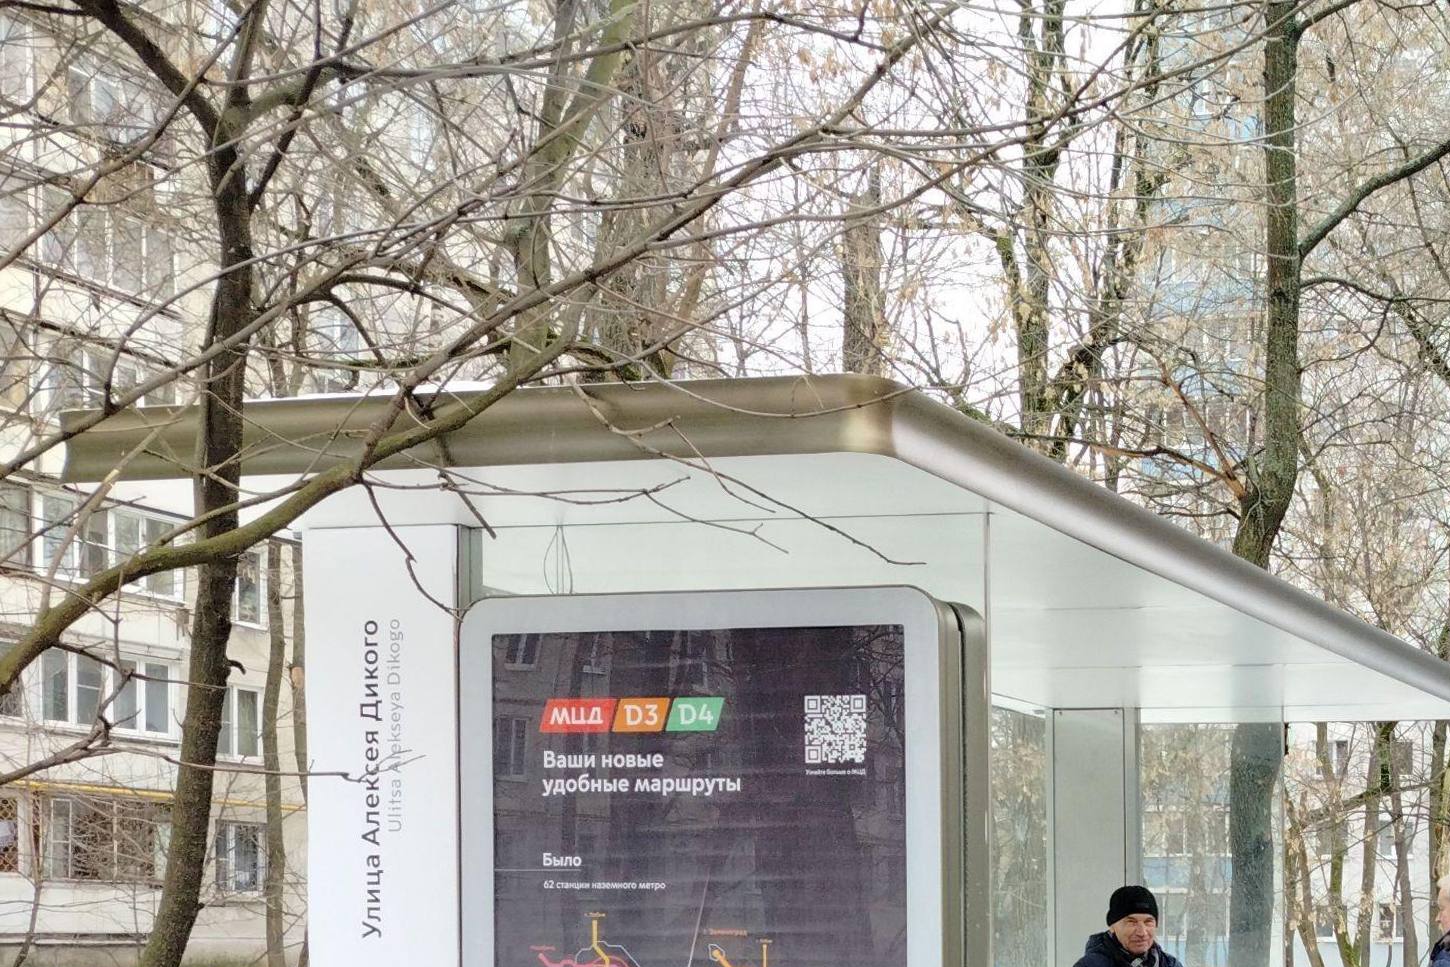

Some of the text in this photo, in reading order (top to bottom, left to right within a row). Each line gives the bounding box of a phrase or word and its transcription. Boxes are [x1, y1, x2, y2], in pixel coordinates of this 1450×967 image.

[549, 703, 604, 726] МЦД
[624, 703, 658, 726] D3
[677, 703, 714, 725] D4
[386, 618, 405, 833] Ulitsa Alekseya Dikogo
[543, 750, 664, 769] Ваши новые
[360, 619, 384, 939] Улица Алексея Дикого
[542, 775, 741, 796] удобные маршруты
[542, 853, 582, 867] Было
[543, 879, 666, 891] 62 станции наземного метро
